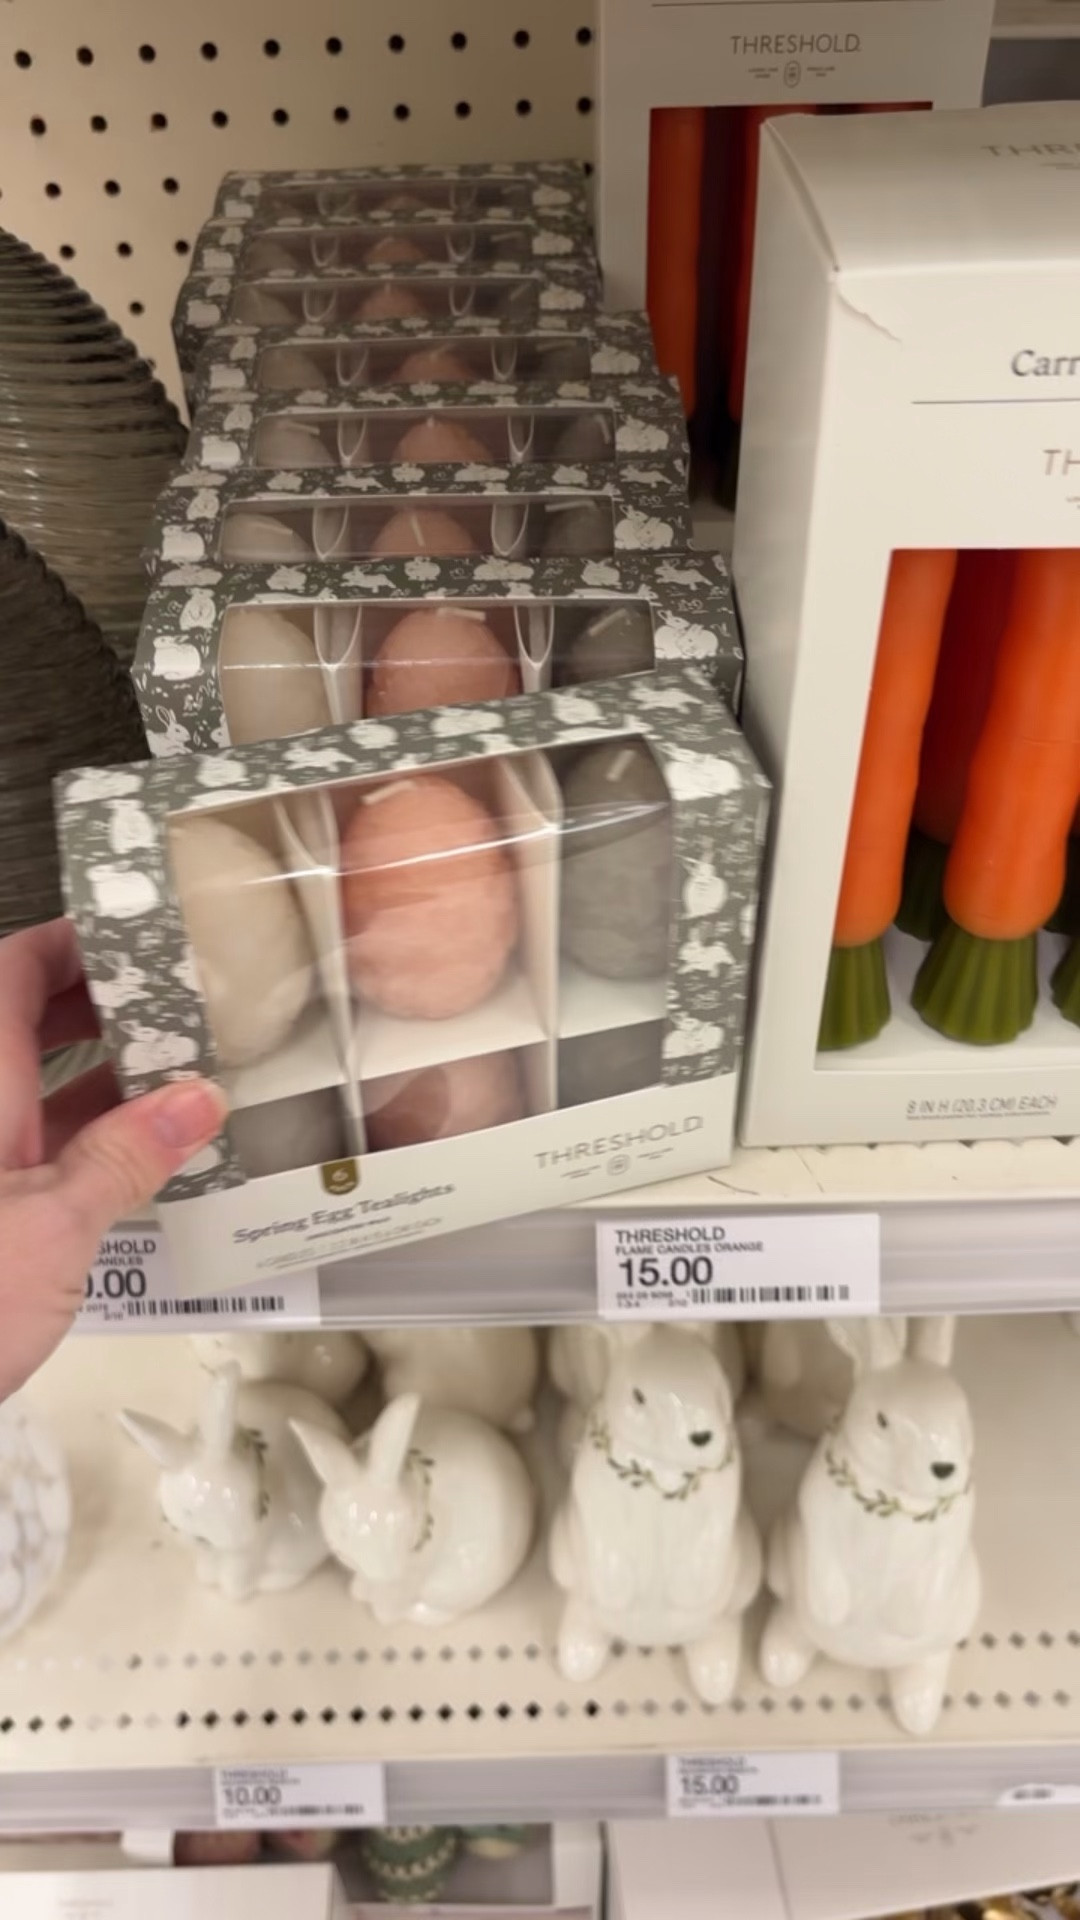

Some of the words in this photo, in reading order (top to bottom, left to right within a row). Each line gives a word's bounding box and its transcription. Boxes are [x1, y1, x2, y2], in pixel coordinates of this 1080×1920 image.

[730, 33, 861, 55] THRESHOLD
[533, 1115, 703, 1169] THRESHOLD
[232, 1216, 309, 1244] Spring
[311, 1206, 356, 1226] Egg
[358, 1183, 456, 1215] Tealights
[615, 1227, 726, 1244] THRESHOLD
[96, 1239, 156, 1255] SHOLD
[615, 1245, 653, 1256] FLAME
[656, 1243, 711, 1255] CANDLES
[714, 1241, 763, 1253] ORANGE
[94, 1256, 143, 1266] ANDLES
[619, 1256, 713, 1287] 15.00
[681, 1774, 740, 1795] 15.00
[223, 1786, 281, 1806] 10.00
